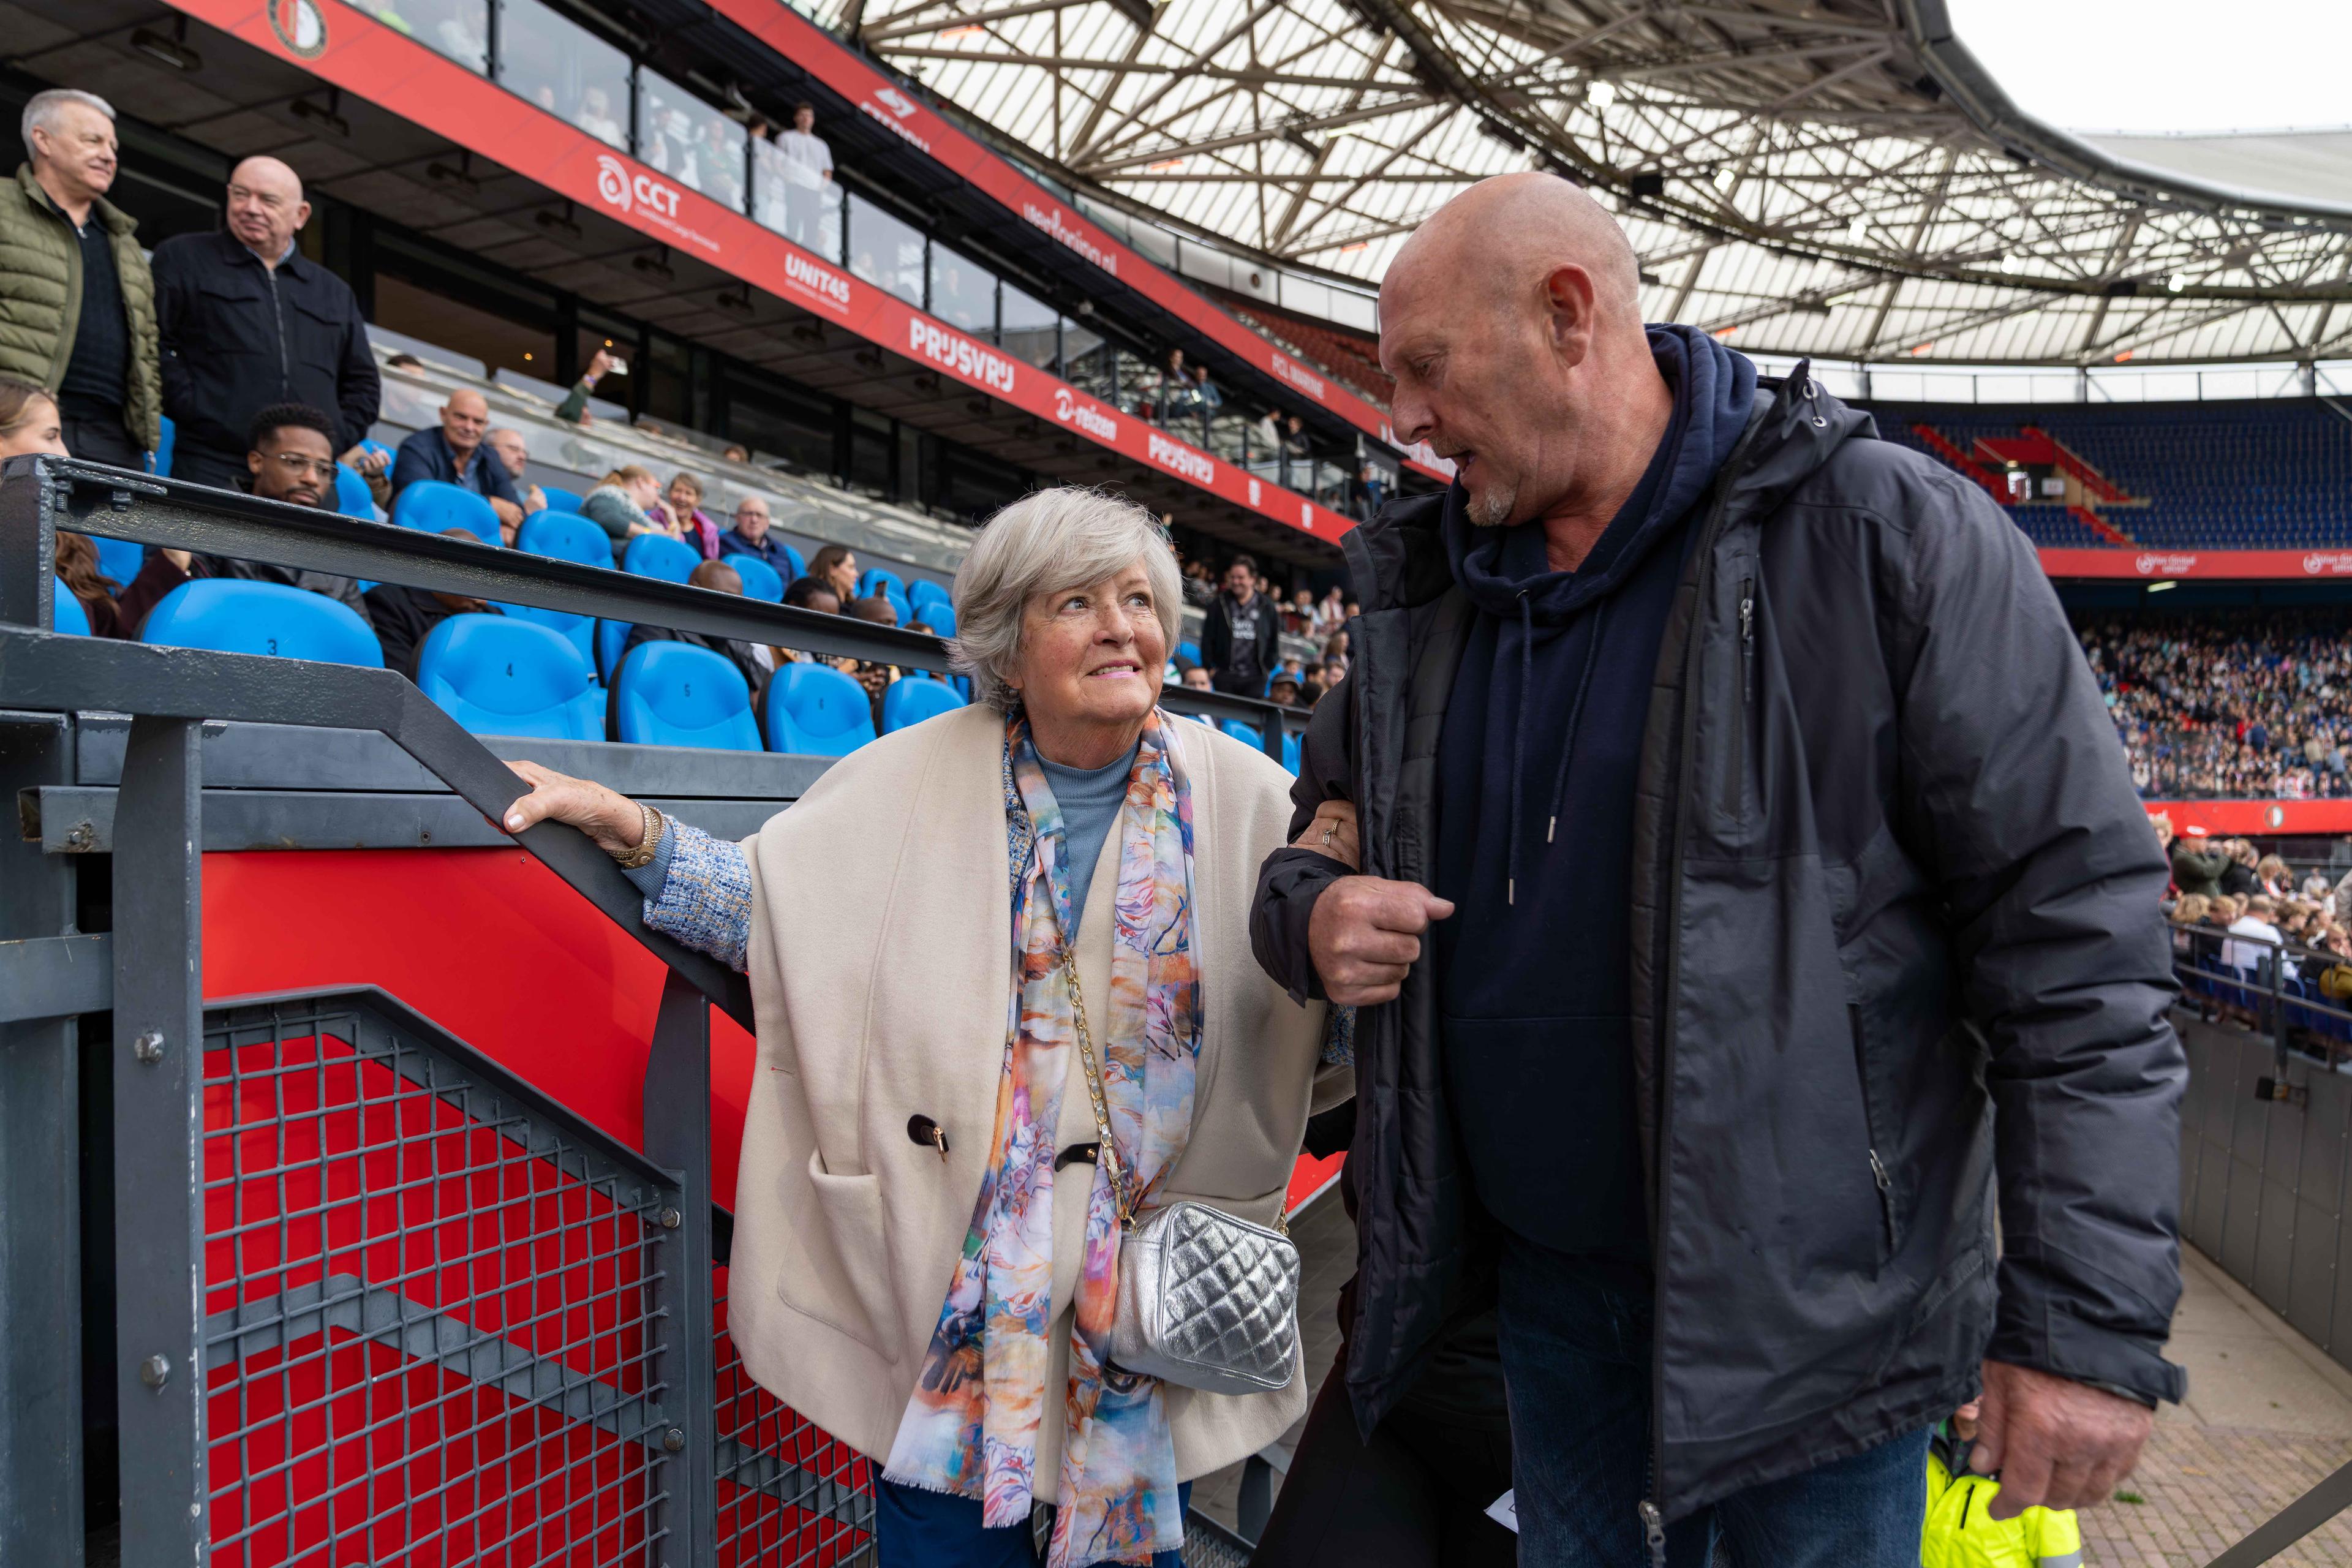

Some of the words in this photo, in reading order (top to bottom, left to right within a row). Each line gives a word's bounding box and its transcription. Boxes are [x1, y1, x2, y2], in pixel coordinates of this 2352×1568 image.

[633, 175, 680, 217] CCT
[785, 252, 850, 304] UNIT45
[268, 639, 277, 656] 3
[506, 662, 513, 677] 4
[684, 683, 691, 698] 5
